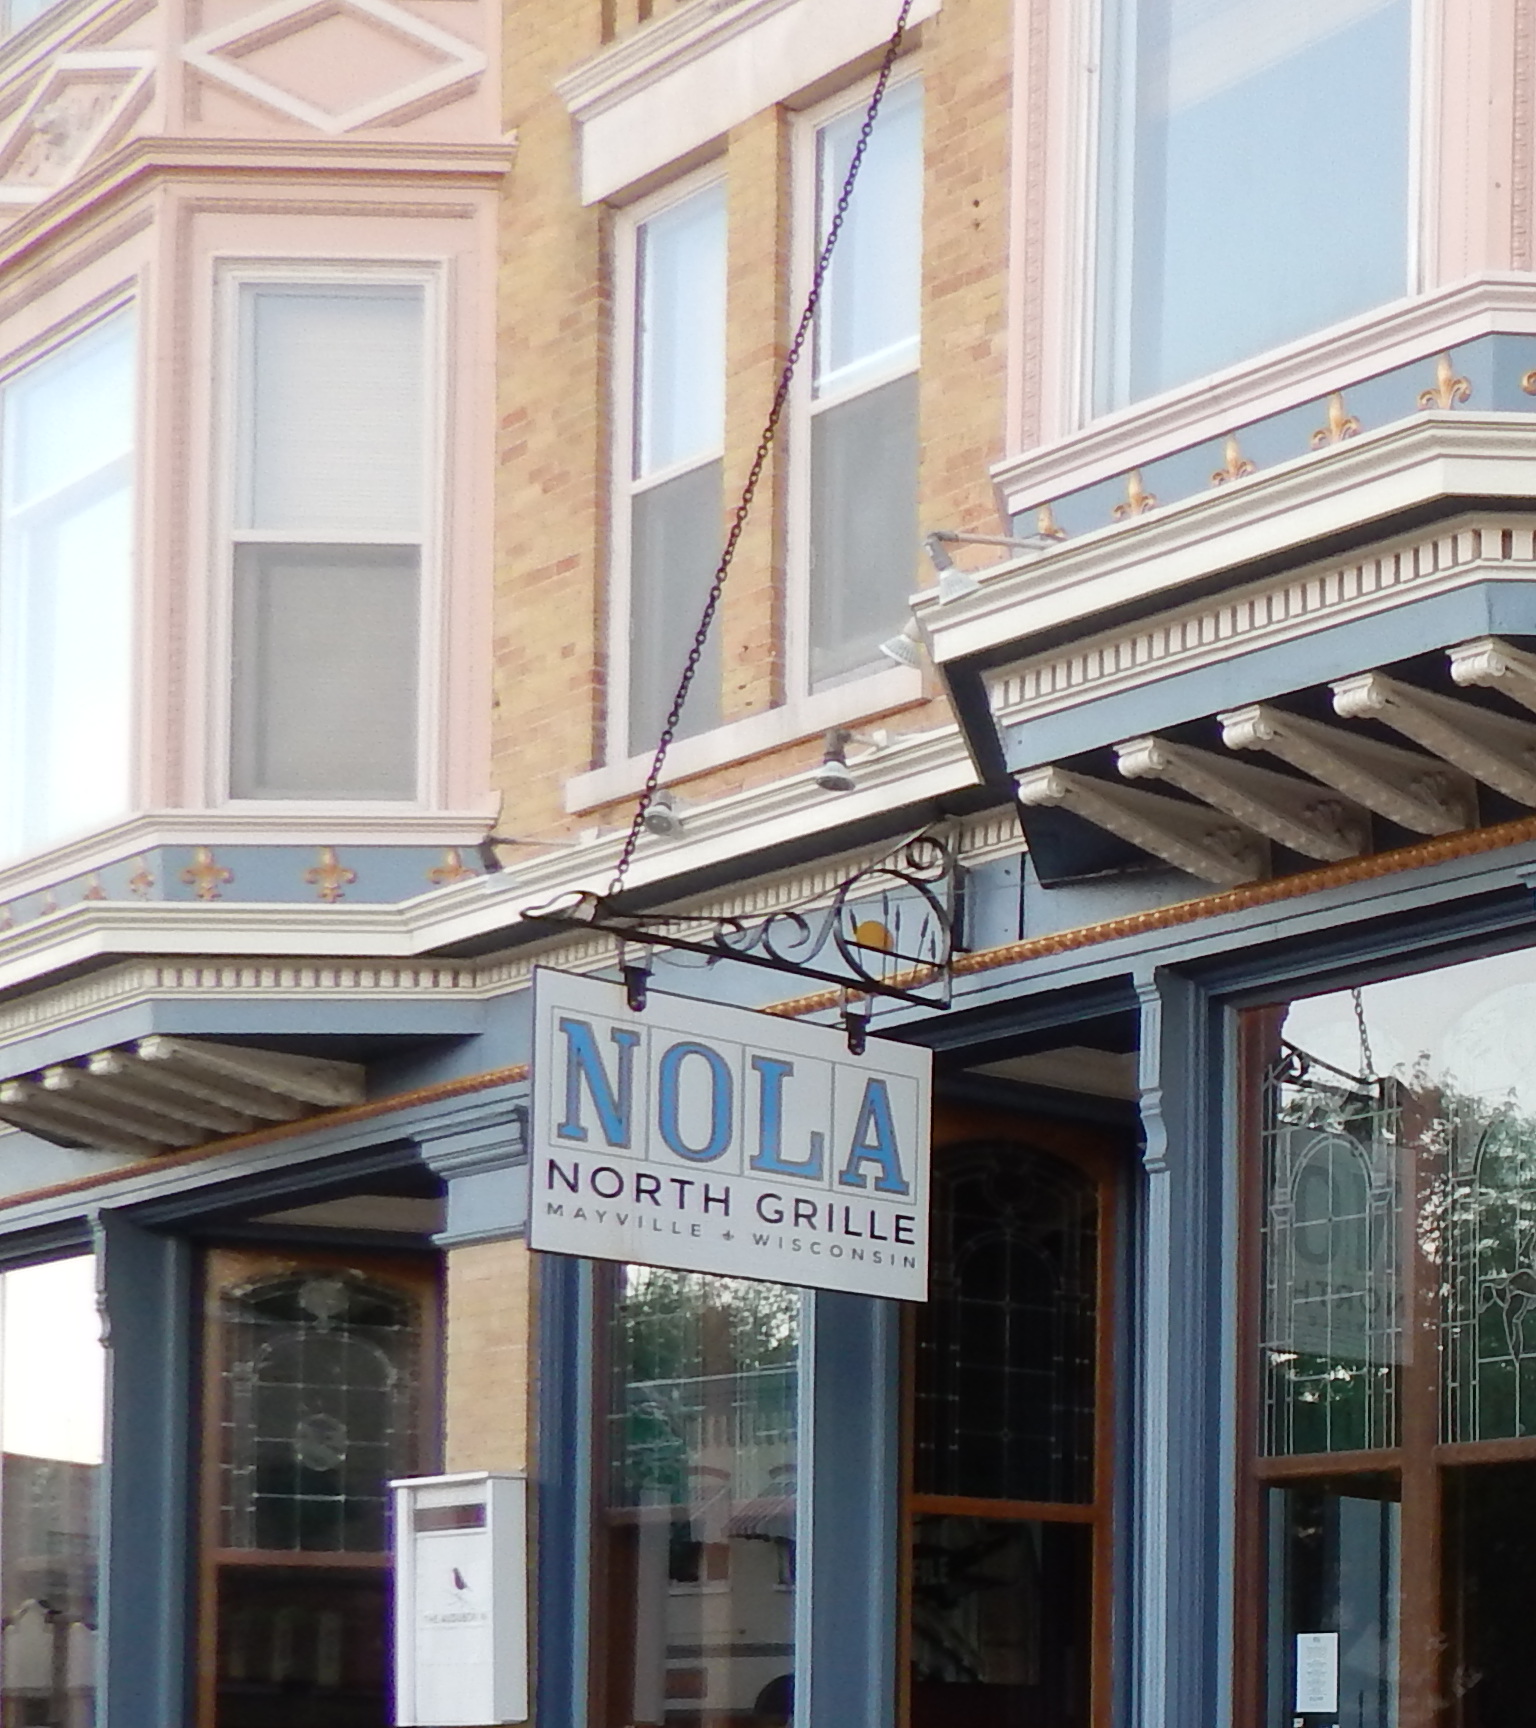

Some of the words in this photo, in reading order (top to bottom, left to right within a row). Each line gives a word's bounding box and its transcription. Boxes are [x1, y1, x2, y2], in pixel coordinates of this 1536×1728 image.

[556, 1016, 910, 1196] NOLA
[547, 1159, 731, 1217] NORTH
[756, 1193, 916, 1245] GRILLE
[547, 1202, 702, 1238] MAYVILLE
[753, 1234, 916, 1269] WISCONSIN
